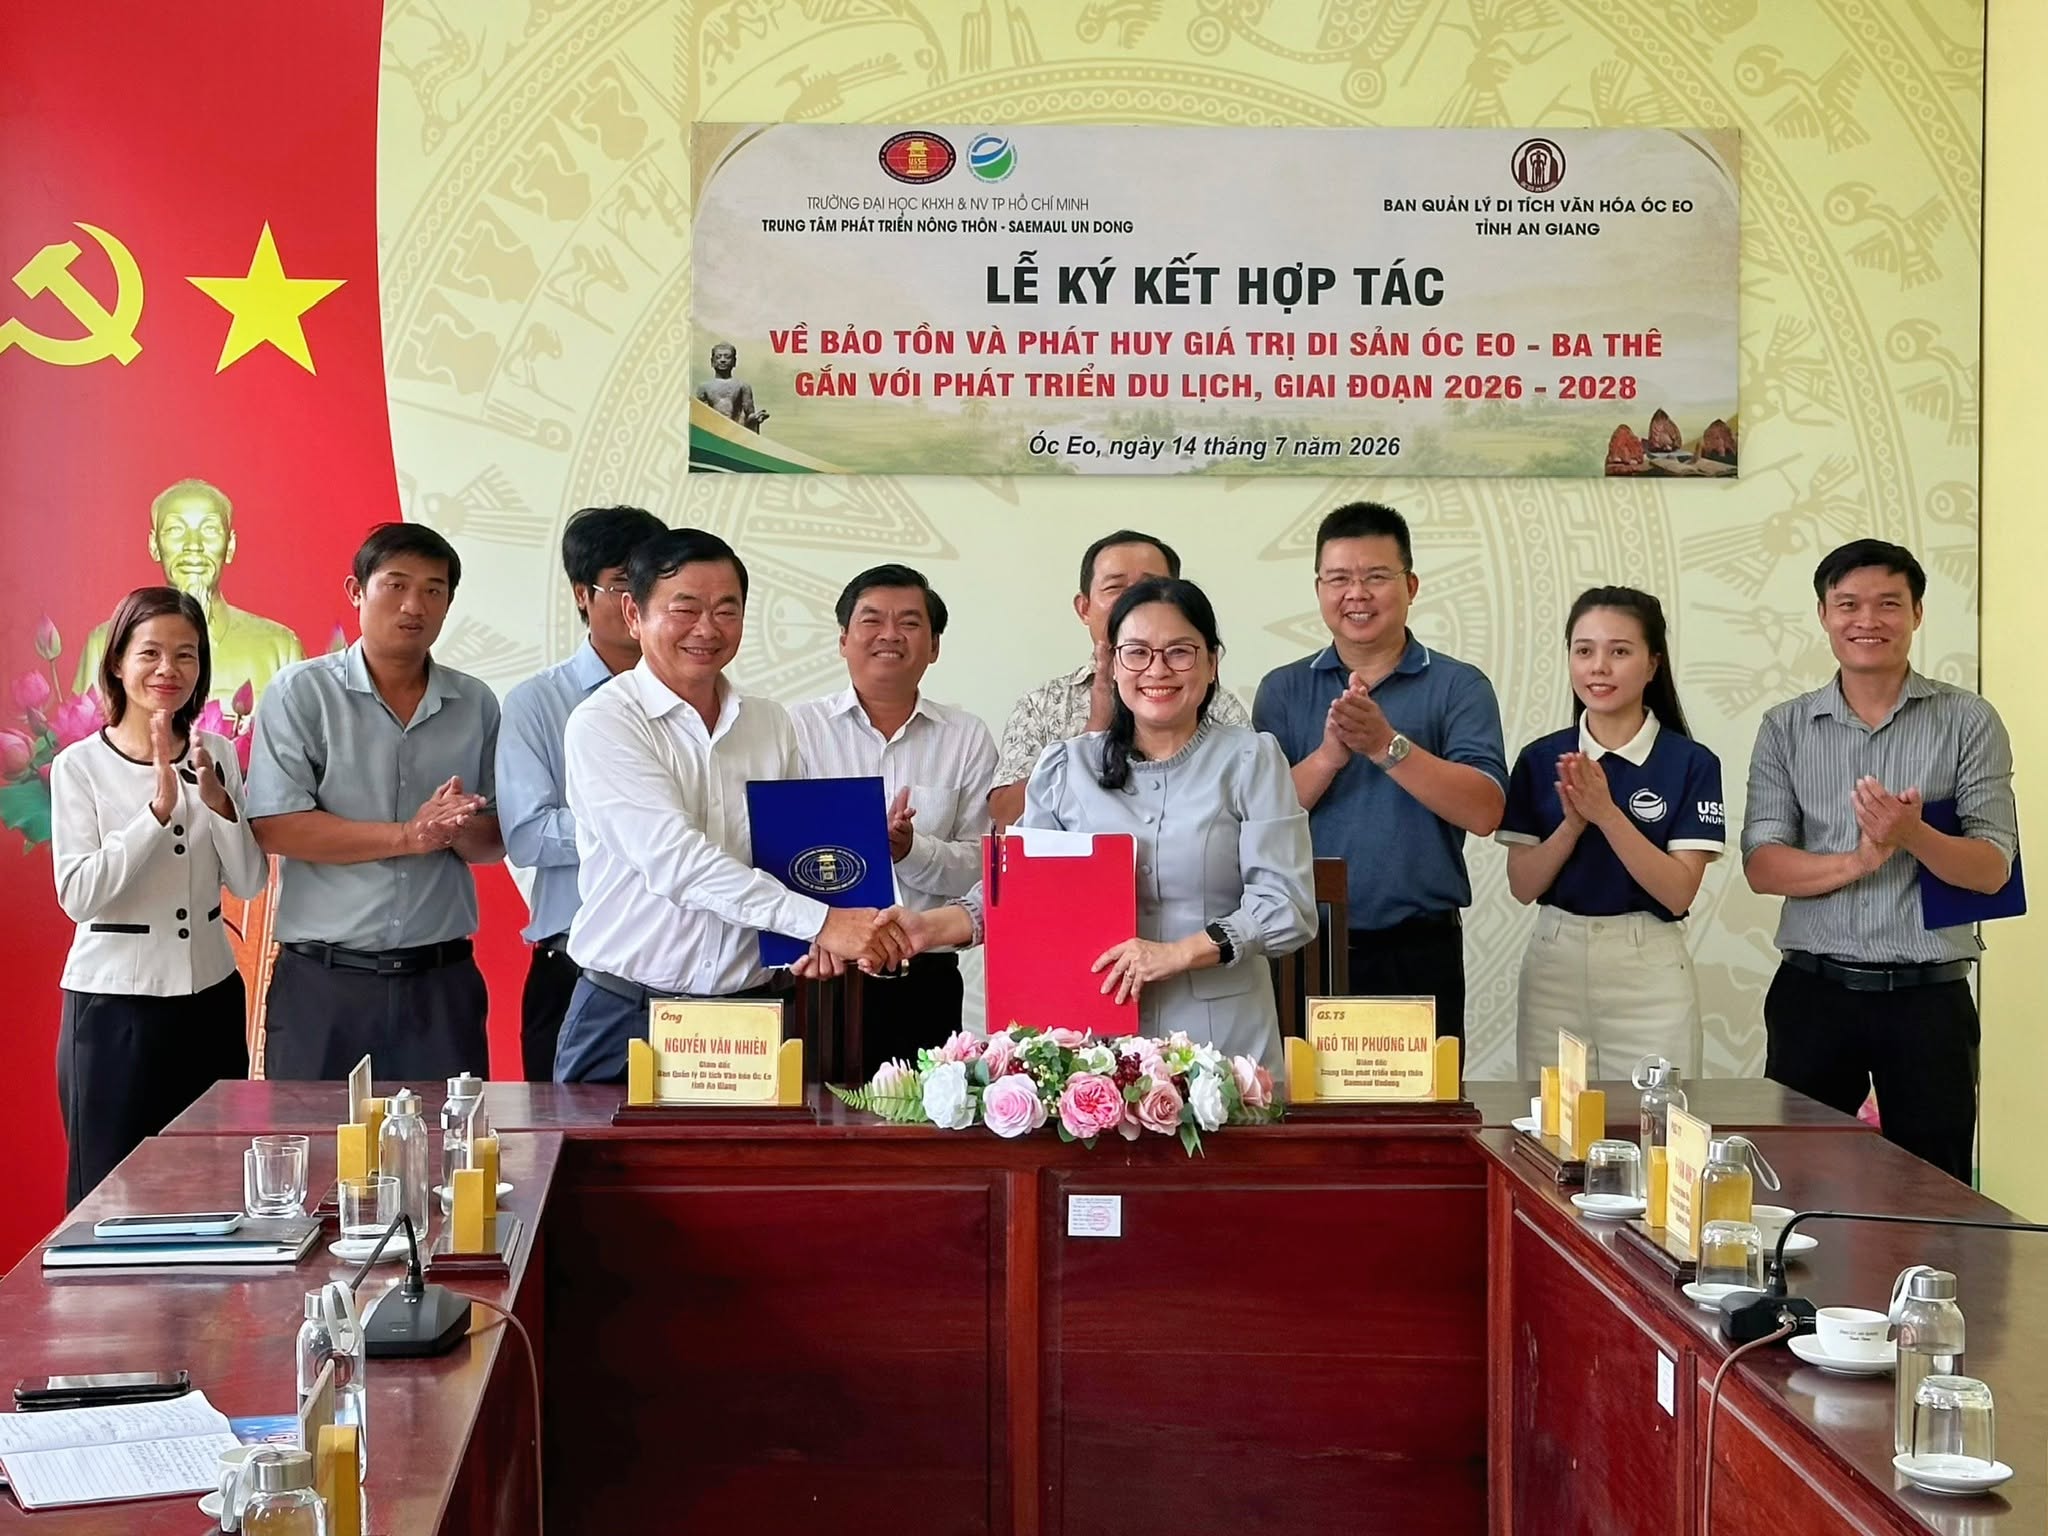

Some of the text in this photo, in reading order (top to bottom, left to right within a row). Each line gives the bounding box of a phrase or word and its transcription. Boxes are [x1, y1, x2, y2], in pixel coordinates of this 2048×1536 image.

[807, 193, 860, 210] TRƯỜNG
[863, 196, 885, 213] ĐẠI
[888, 196, 918, 214] HỌC
[921, 197, 954, 210] KHXH
[957, 197, 967, 211] &
[970, 197, 989, 211] NV
[991, 197, 1006, 211] TP
[1030, 194, 1054, 211] CHÍ
[1056, 197, 1089, 211] MINH
[1383, 194, 1694, 213] BAN QUẢN LÝ DI TÍCH VĂN HÓA ÓC EO
[761, 219, 806, 232] TRUNG
[809, 216, 837, 232] TÂM
[841, 216, 875, 233] PHÁT
[877, 211, 913, 233] TRIỂN
[917, 216, 958, 233] NÔNG
[961, 216, 997, 233] THÔN
[1008, 220, 1068, 233] SAEMAUL
[1071, 220, 1089, 234] UN
[1093, 220, 1134, 234] DONG
[1475, 218, 1601, 236] TỈNH AN GIANG
[987, 250, 1444, 315] LỄ KÝ KẾT HỢP TÁC
[769, 321, 808, 354] VỀ
[820, 323, 882, 355] BẢO
[893, 321, 954, 355] TỒN
[966, 324, 1007, 355] VÀ
[1018, 325, 1100, 355] PHÁT
[1111, 331, 1173, 356] HUY
[1184, 326, 1236, 356] GIÁ
[1245, 332, 1295, 361] TRỊ
[1308, 332, 1337, 356] DI
[1349, 325, 1409, 356] SẢN
[1422, 326, 1464, 357] ÓC
[1476, 332, 1515, 357] EO
[1552, 333, 1593, 357] BA
[1602, 327, 1662, 357] THÊ
[795, 363, 857, 397] GẮN
[868, 366, 921, 397] VỚI
[934, 366, 1015, 397] PHÁT
[1024, 362, 1115, 397] TRIỂN
[1128, 373, 1169, 398] DU
[1182, 373, 1262, 403] LỊCH,
[1274, 373, 1336, 398] GIAI
[1346, 374, 1432, 404] ĐOẠN
[1444, 374, 1522, 399] 2026
[1558, 375, 1637, 400] 2028
[1029, 430, 1401, 460] Óc Eo, ngày 14 tháng 7 năm 2026
[710, 1036, 731, 1055] VĂN
[1341, 1036, 1359, 1055] THỊ
[1408, 1036, 1428, 1053] LAN
